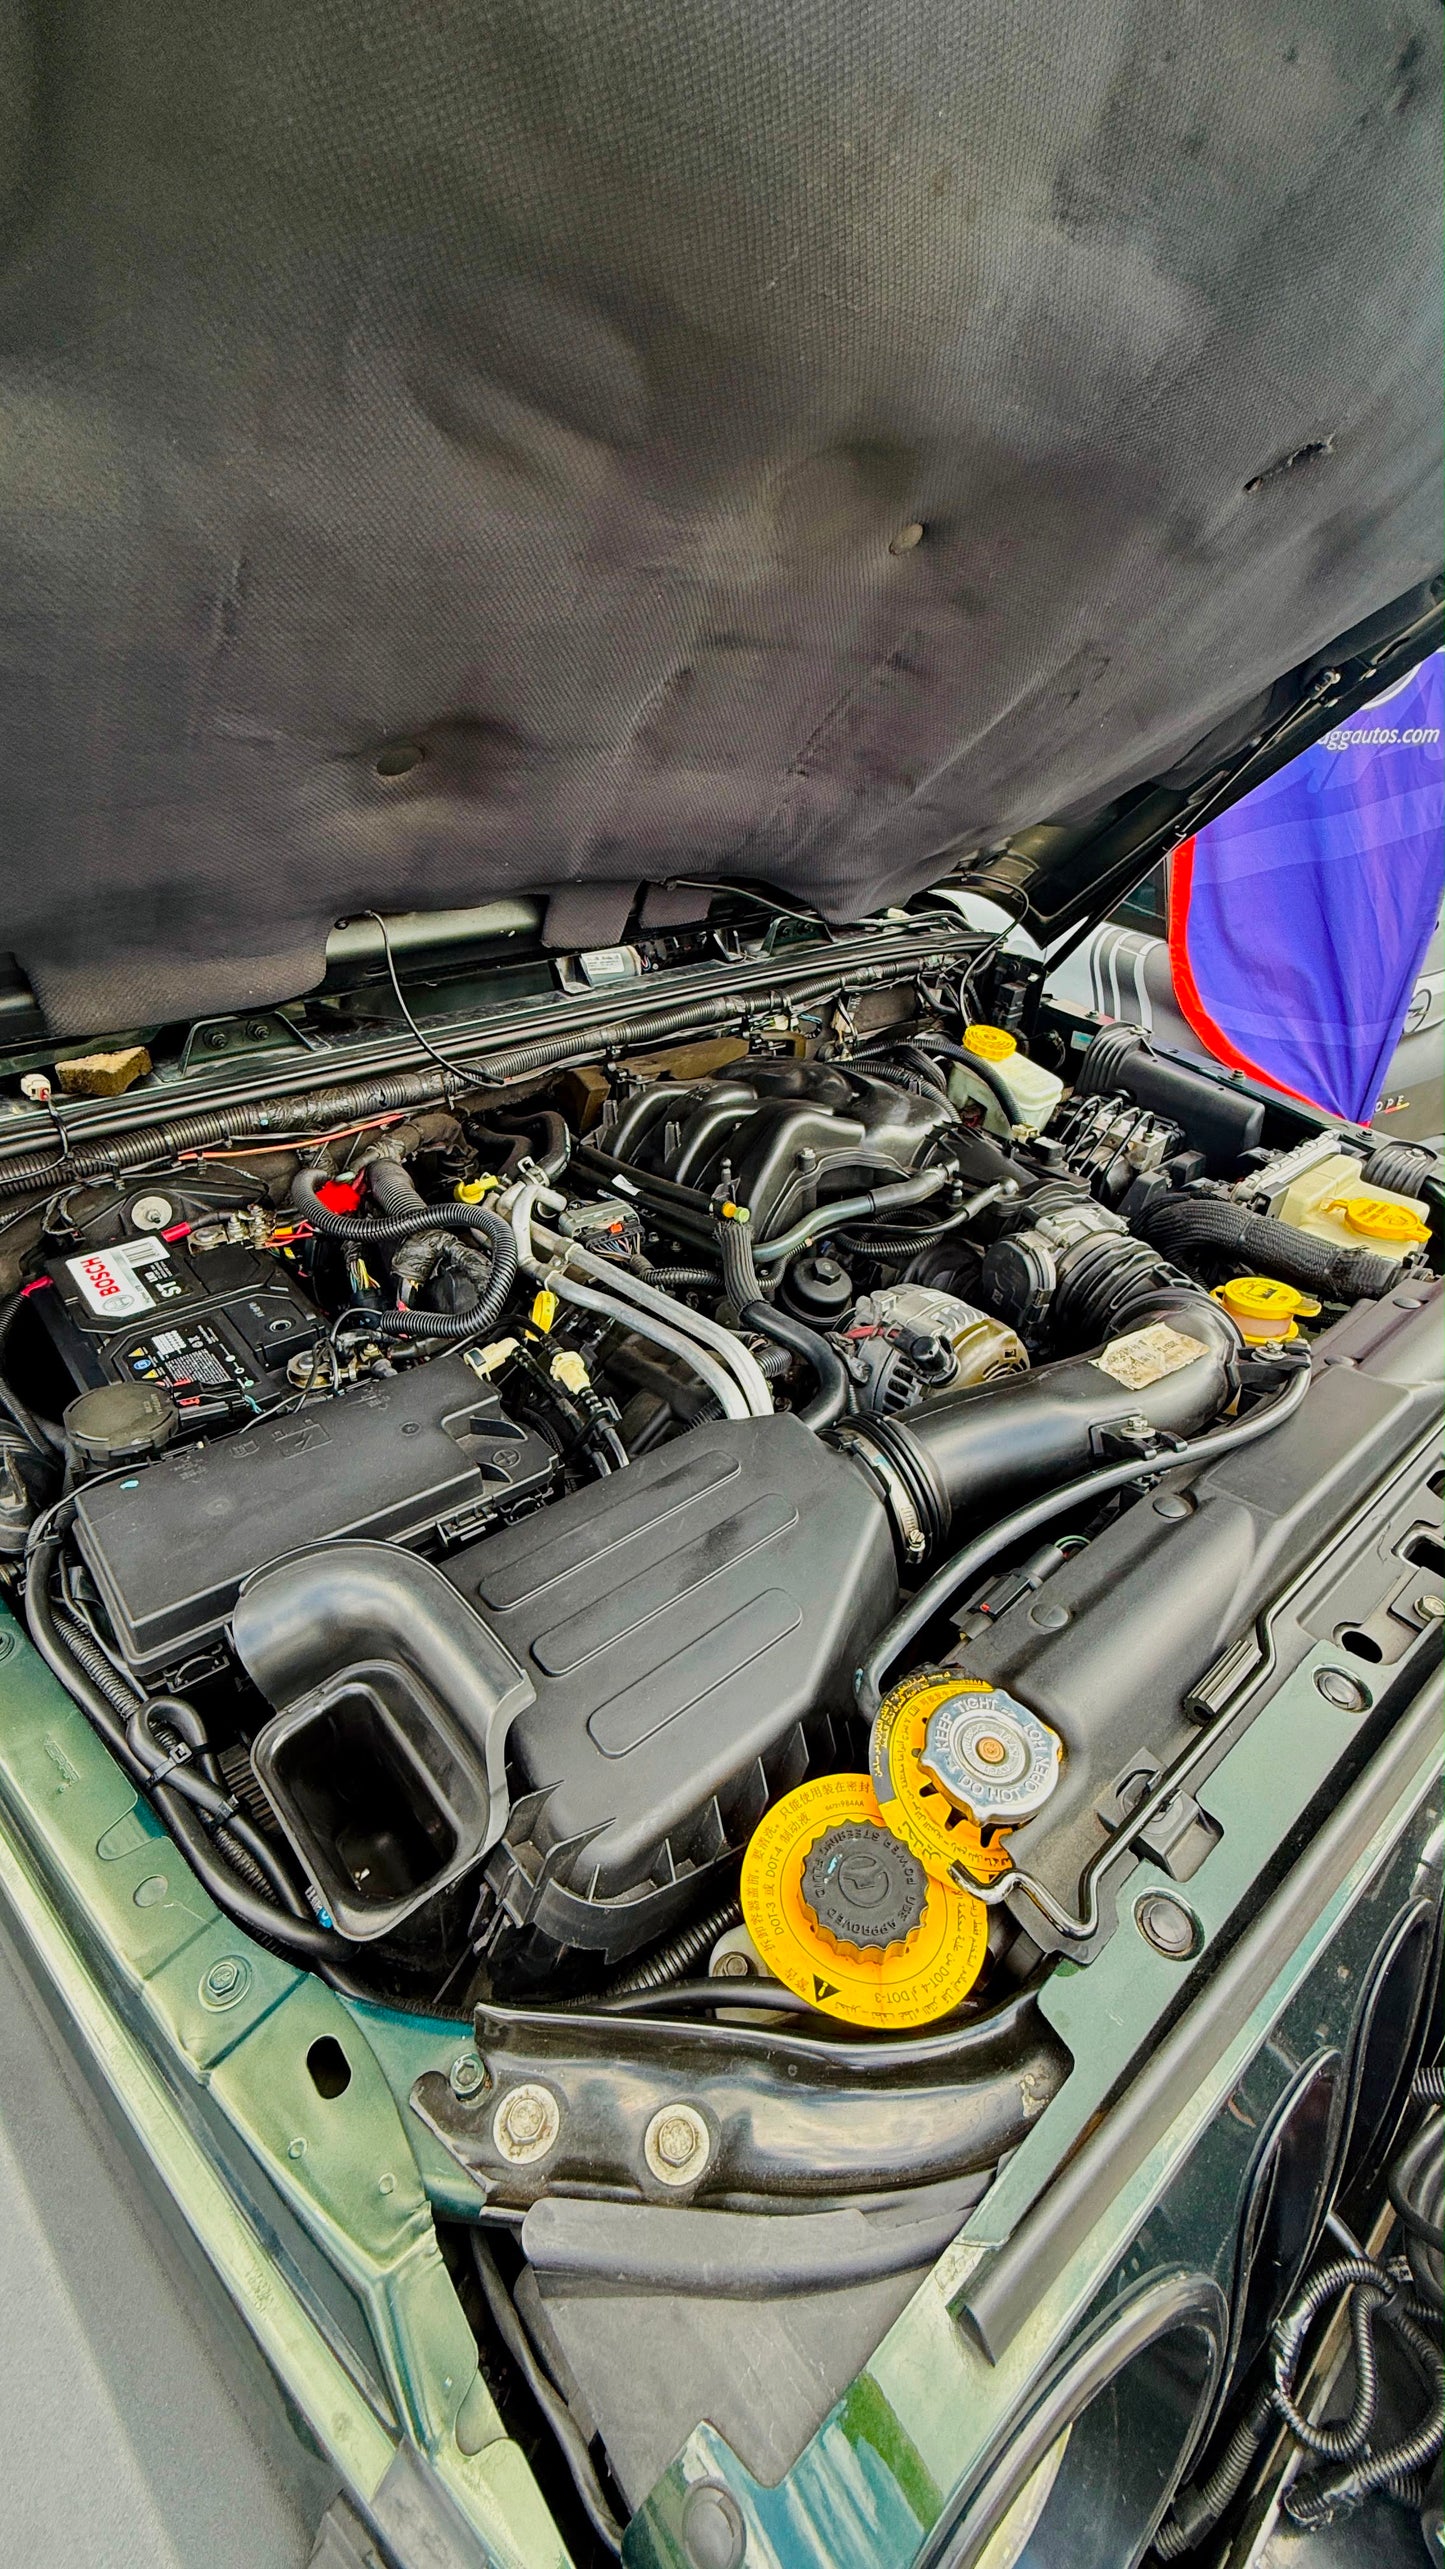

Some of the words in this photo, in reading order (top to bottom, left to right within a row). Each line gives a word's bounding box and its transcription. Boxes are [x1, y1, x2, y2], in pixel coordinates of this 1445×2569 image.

[80, 1256, 121, 1297] BOSCH
[935, 1713, 954, 1751] KEEP
[953, 1697, 999, 1713] TIGHT
[1022, 1722, 1048, 1751] HOT
[958, 1774, 984, 1796] DO
[1024, 1756, 1049, 1792] OPEN
[987, 1785, 1022, 1802] NOT
[820, 1829, 880, 1856] STEERING
[766, 1846, 783, 1879] DOT-4
[812, 1858, 825, 1898] FLUID
[883, 1839, 916, 1885] POWER
[768, 1902, 784, 1936] DOT-3
[827, 1908, 896, 1936] APPROVED
[898, 1896, 916, 1921] USE
[874, 1984, 910, 2010] DOT-3
[920, 1965, 950, 1995] DOT-4
